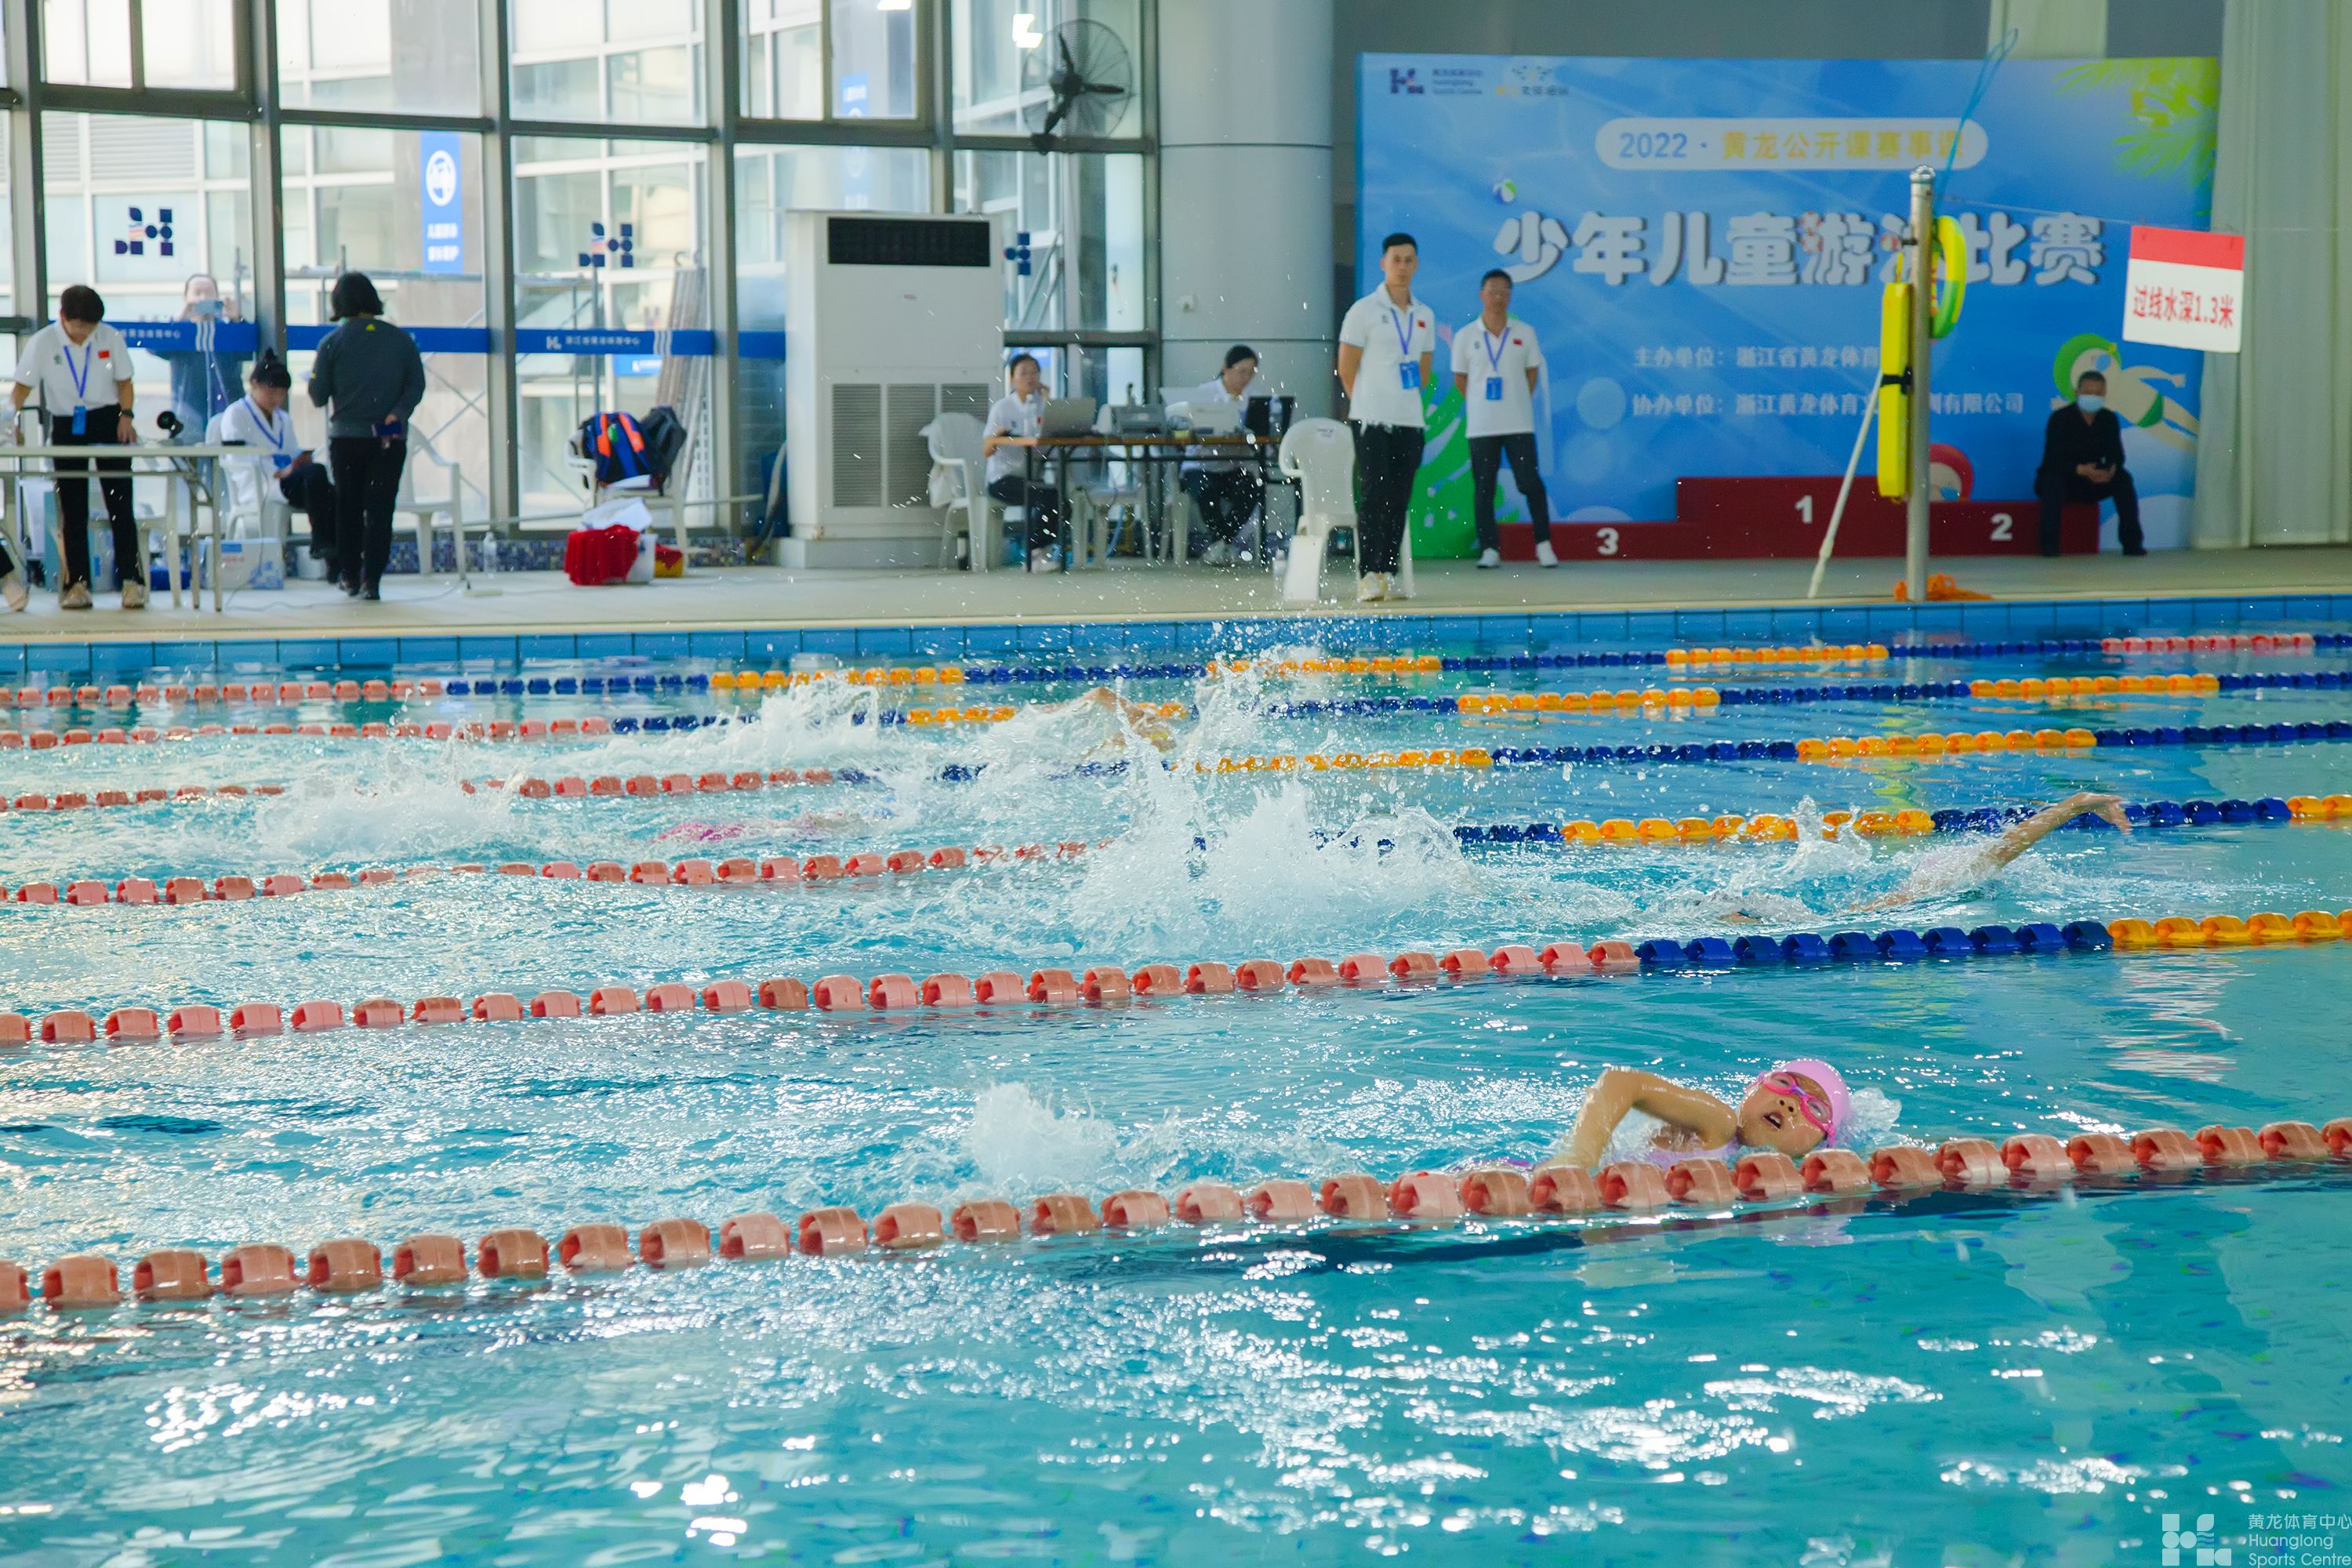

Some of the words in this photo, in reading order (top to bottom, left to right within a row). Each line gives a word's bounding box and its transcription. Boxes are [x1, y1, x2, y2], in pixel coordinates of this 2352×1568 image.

[1619, 132, 1688, 158] 2022
[2133, 285, 2234, 329] 过线水深1.3米
[1795, 495, 1813, 524] 1
[1597, 528, 1620, 556] 3
[1990, 514, 2013, 542] 2
